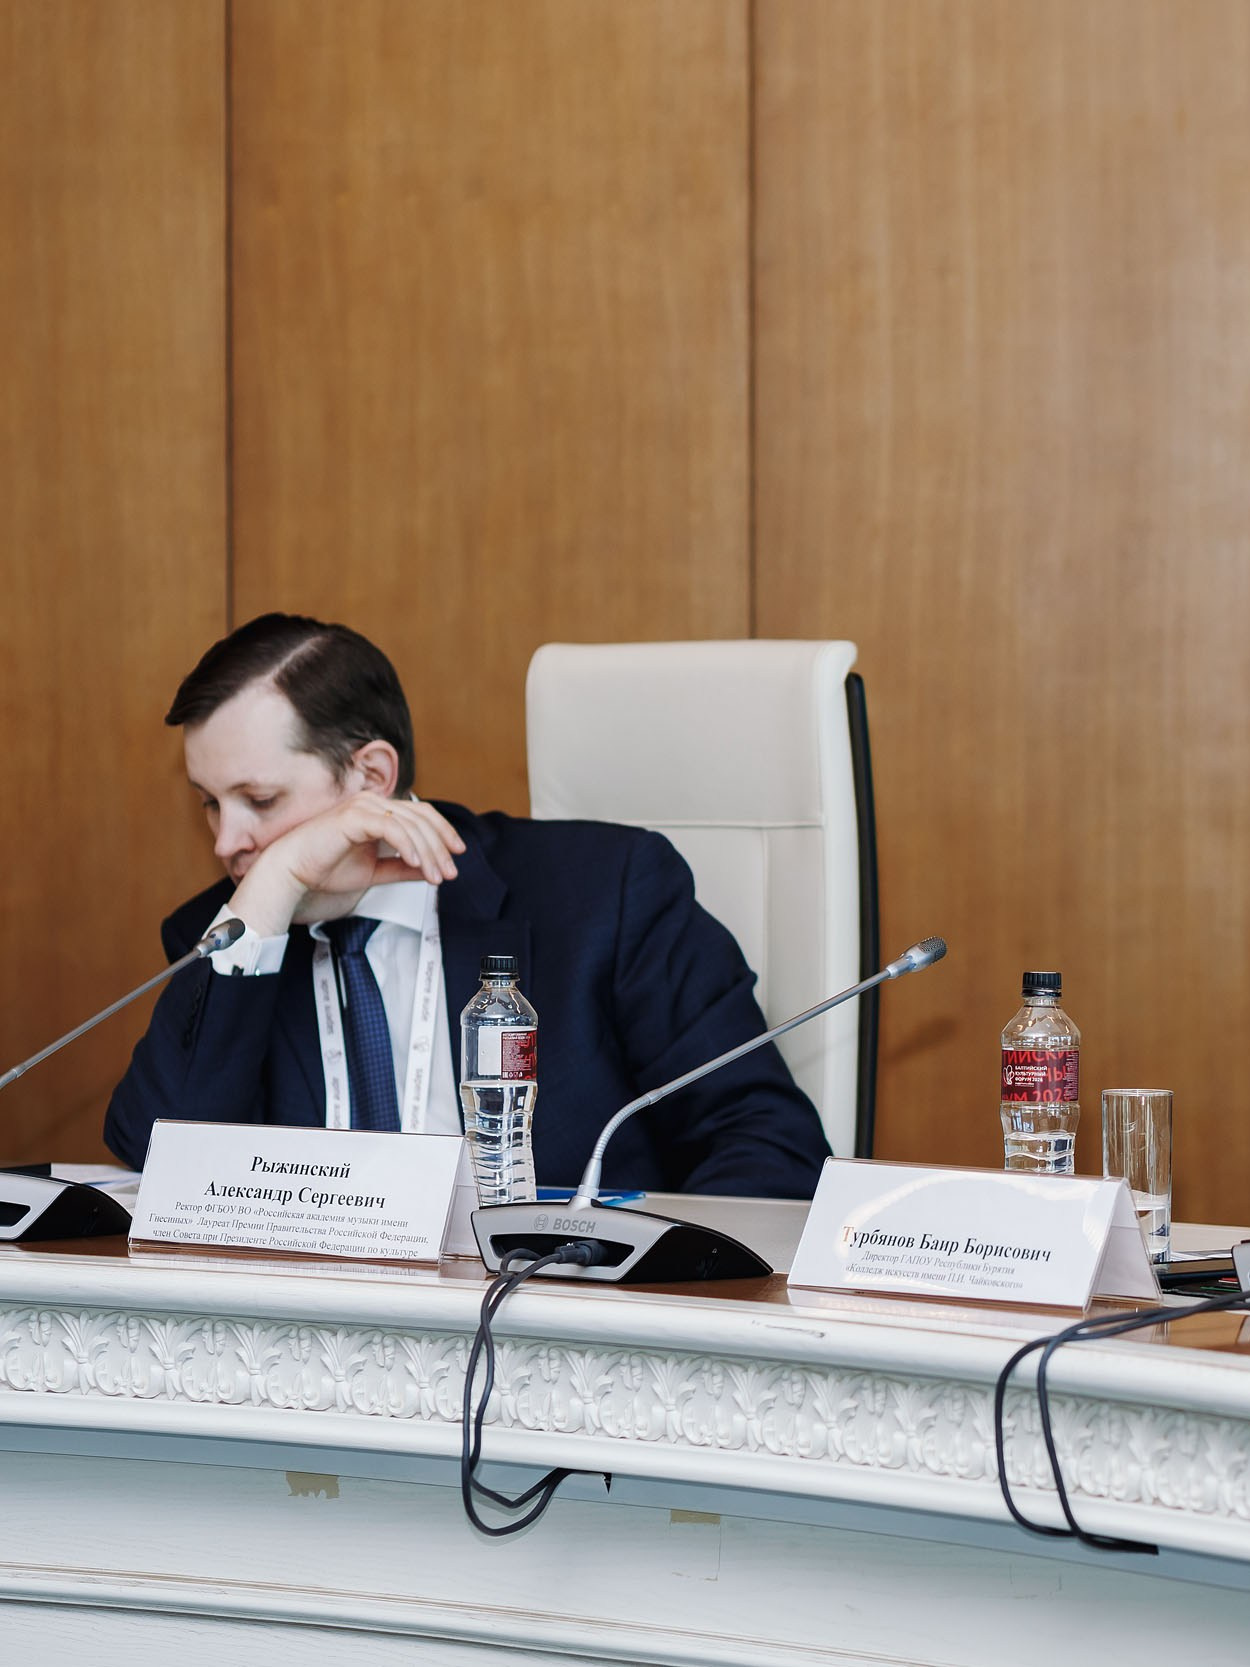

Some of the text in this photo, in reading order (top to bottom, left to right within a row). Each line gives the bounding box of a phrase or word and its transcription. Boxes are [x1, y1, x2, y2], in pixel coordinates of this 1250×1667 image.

[250, 1156, 350, 1178] Рыжинский
[204, 1181, 386, 1208] Александр Сергеевич
[148, 1213, 194, 1225] Гнесиных»
[196, 1217, 230, 1228] Лауреат
[231, 1220, 264, 1231] Премии
[266, 1222, 327, 1236] Правительства
[328, 1227, 378, 1240] Российской
[174, 1202, 408, 1228] Ректор ФГБОУ ВО «Российская академия музыки имени
[552, 1218, 596, 1233] BOSCH
[152, 1230, 418, 1259] член Совета при Президенте Российской Федерации по культуре
[842, 1226, 1051, 1262] Турбянов Баир Борисович
[846, 1263, 883, 1275] «Колледж
[885, 1268, 918, 1278] искусств
[920, 1272, 946, 1281] имени
[947, 1273, 966, 1284] П.И.
[861, 1250, 1016, 1276] Директор ГАПОУ Республики Бурятия
